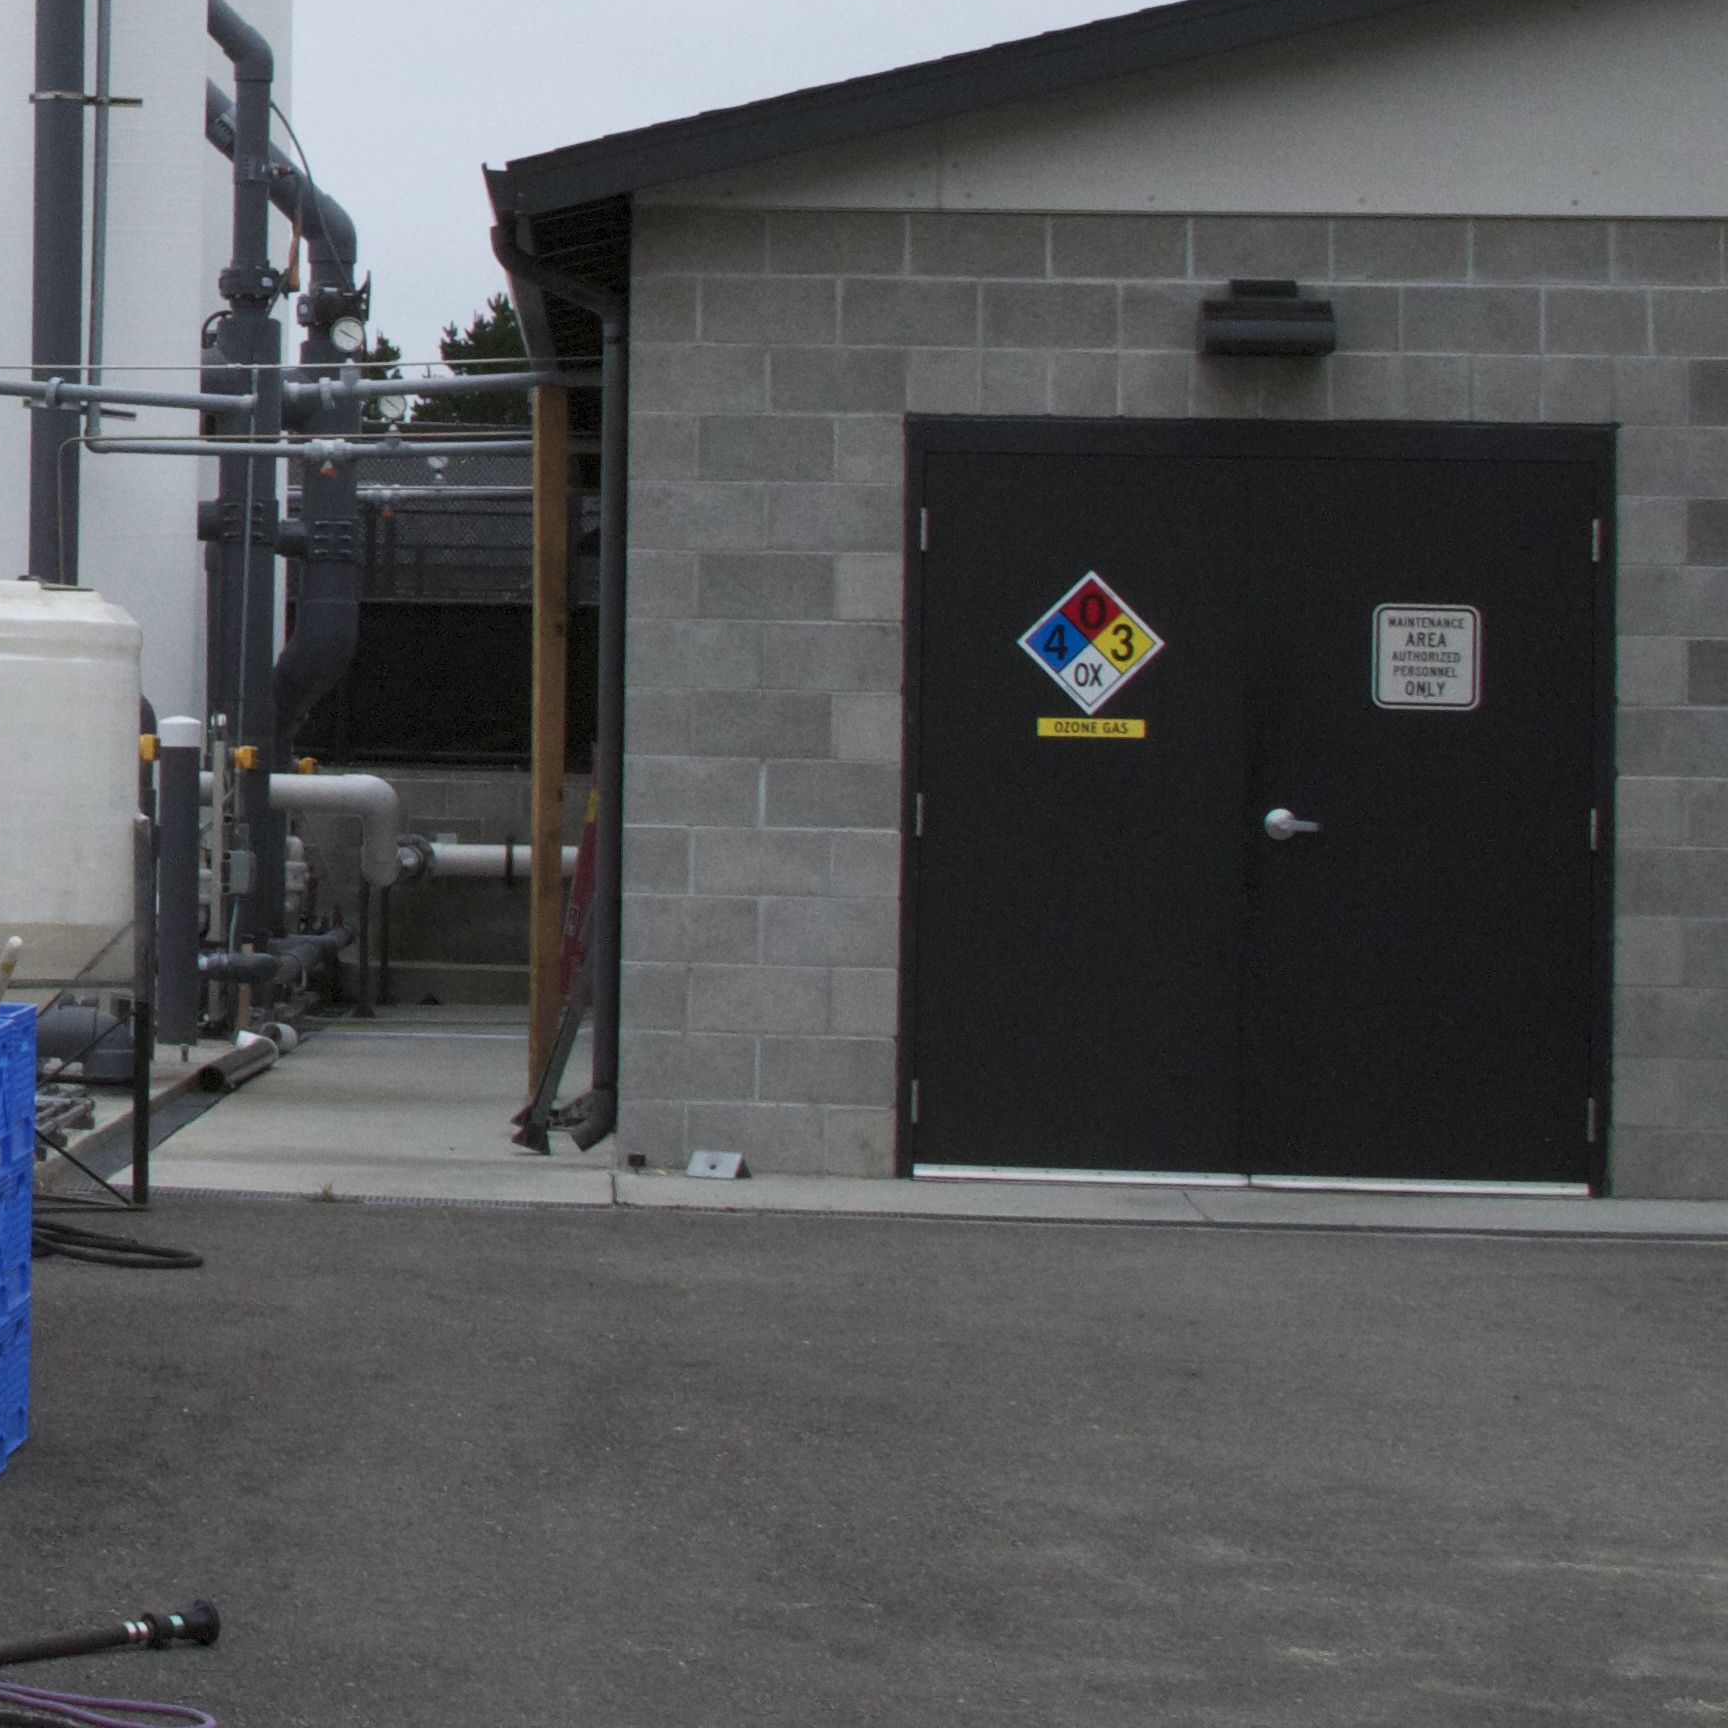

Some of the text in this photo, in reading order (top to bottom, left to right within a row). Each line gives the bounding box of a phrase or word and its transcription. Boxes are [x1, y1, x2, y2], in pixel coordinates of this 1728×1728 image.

[1079, 592, 1106, 630] 0
[1388, 617, 1465, 629] MAINTENANCE
[1044, 624, 1068, 660] 4
[1110, 624, 1134, 662] 3
[1405, 632, 1447, 648] AREA
[1392, 651, 1461, 664] AUTHORIZED
[1074, 662, 1103, 688] OX
[1392, 665, 1458, 678] PERSONNEL
[1405, 681, 1446, 698] ONLY
[1054, 721, 1128, 734] OZONE GAS
